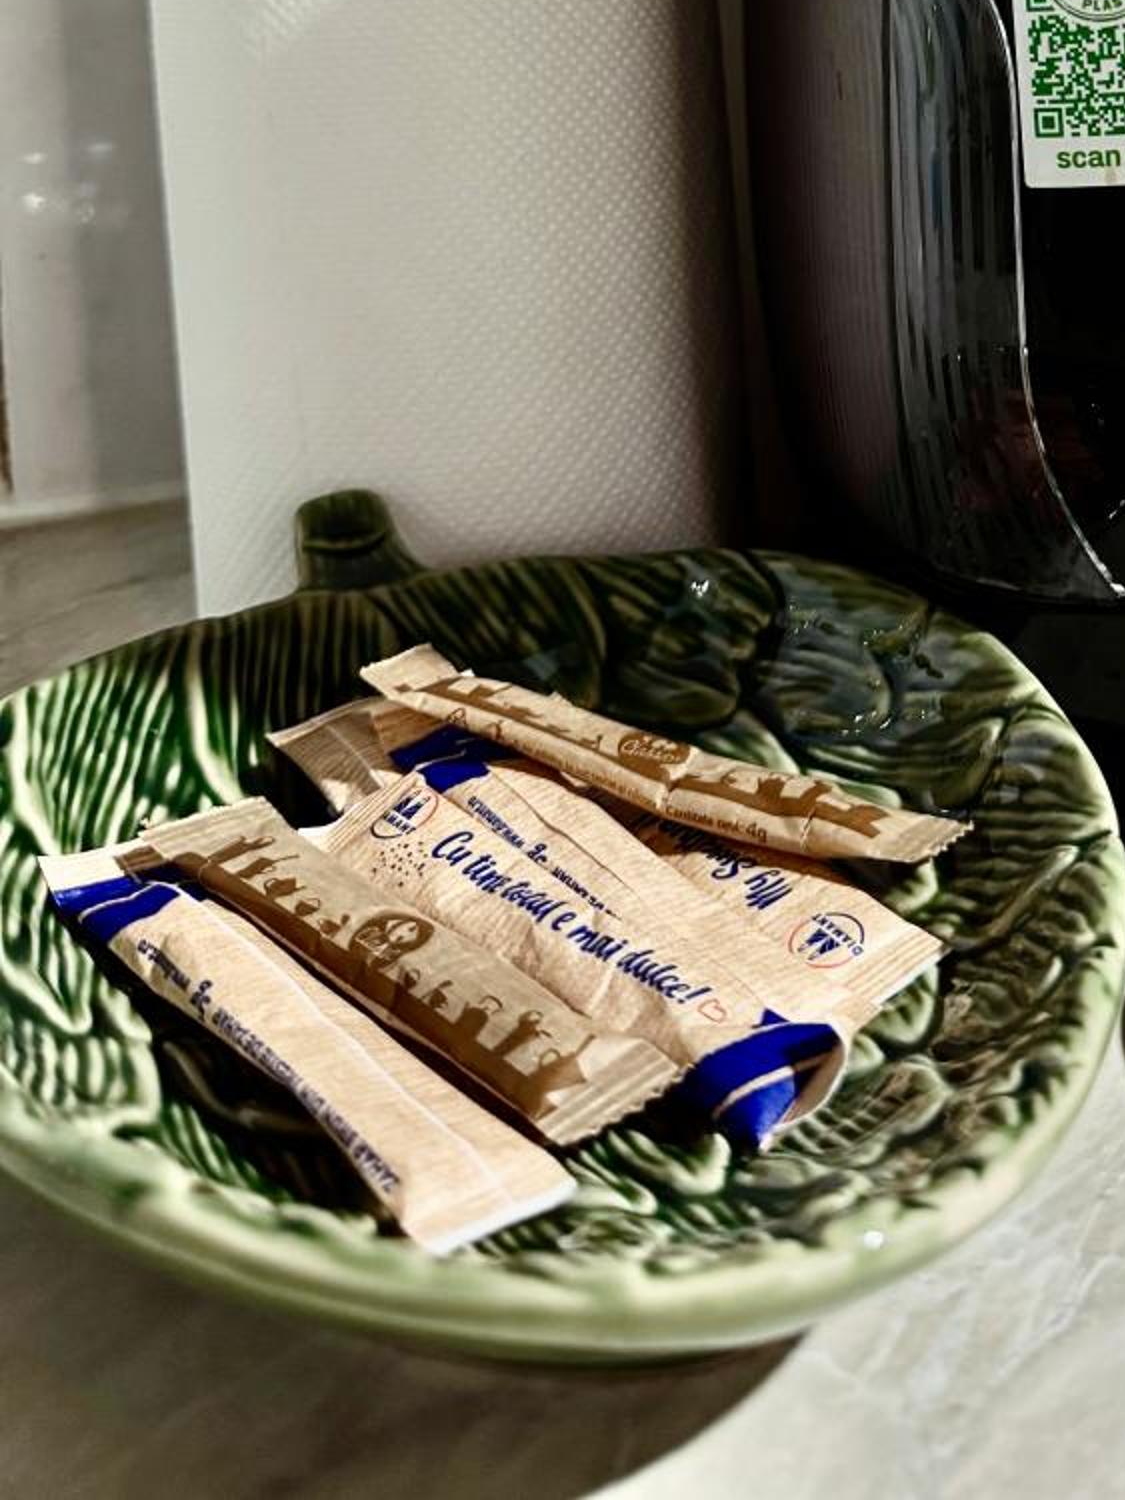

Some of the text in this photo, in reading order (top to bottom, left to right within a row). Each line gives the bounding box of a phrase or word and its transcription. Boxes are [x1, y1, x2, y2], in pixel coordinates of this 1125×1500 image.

[1056, 149, 1121, 169] scan
[744, 870, 793, 910] My
[431, 830, 474, 866] Cu
[551, 911, 577, 931] e
[566, 925, 629, 962] mai
[616, 949, 713, 1004] dulce!
[811, 913, 864, 956] DIAMANT
